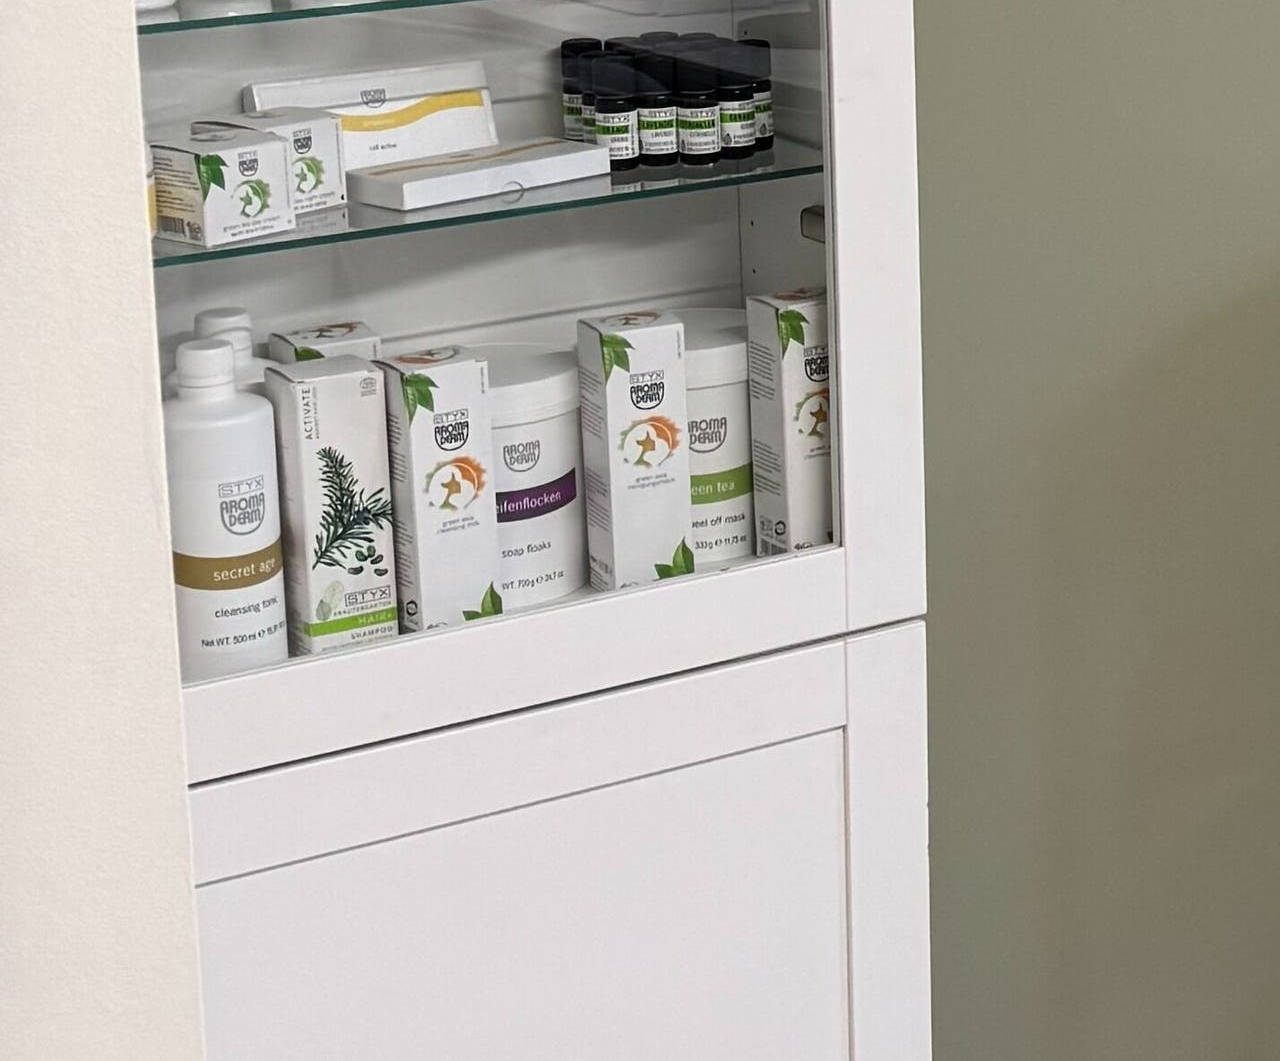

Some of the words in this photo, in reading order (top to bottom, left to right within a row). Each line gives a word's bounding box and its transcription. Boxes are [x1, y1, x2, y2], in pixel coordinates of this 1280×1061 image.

[301, 387, 313, 440] ACTIVATE
[434, 420, 470, 436] AROMA
[689, 429, 722, 445] DERM
[503, 439, 541, 456] AROMA
[509, 451, 537, 467] DERM
[219, 476, 264, 497] STYX
[717, 479, 736, 493] tea
[219, 492, 266, 515] AROMA
[496, 490, 562, 514] ifenflocken
[228, 508, 262, 528] DERM
[710, 515, 722, 528] off
[502, 547, 524, 559] soap
[213, 563, 255, 582] secret
[344, 586, 391, 606] STYX
[214, 602, 261, 619] cleansing
[351, 625, 393, 640] SHAMPOO
